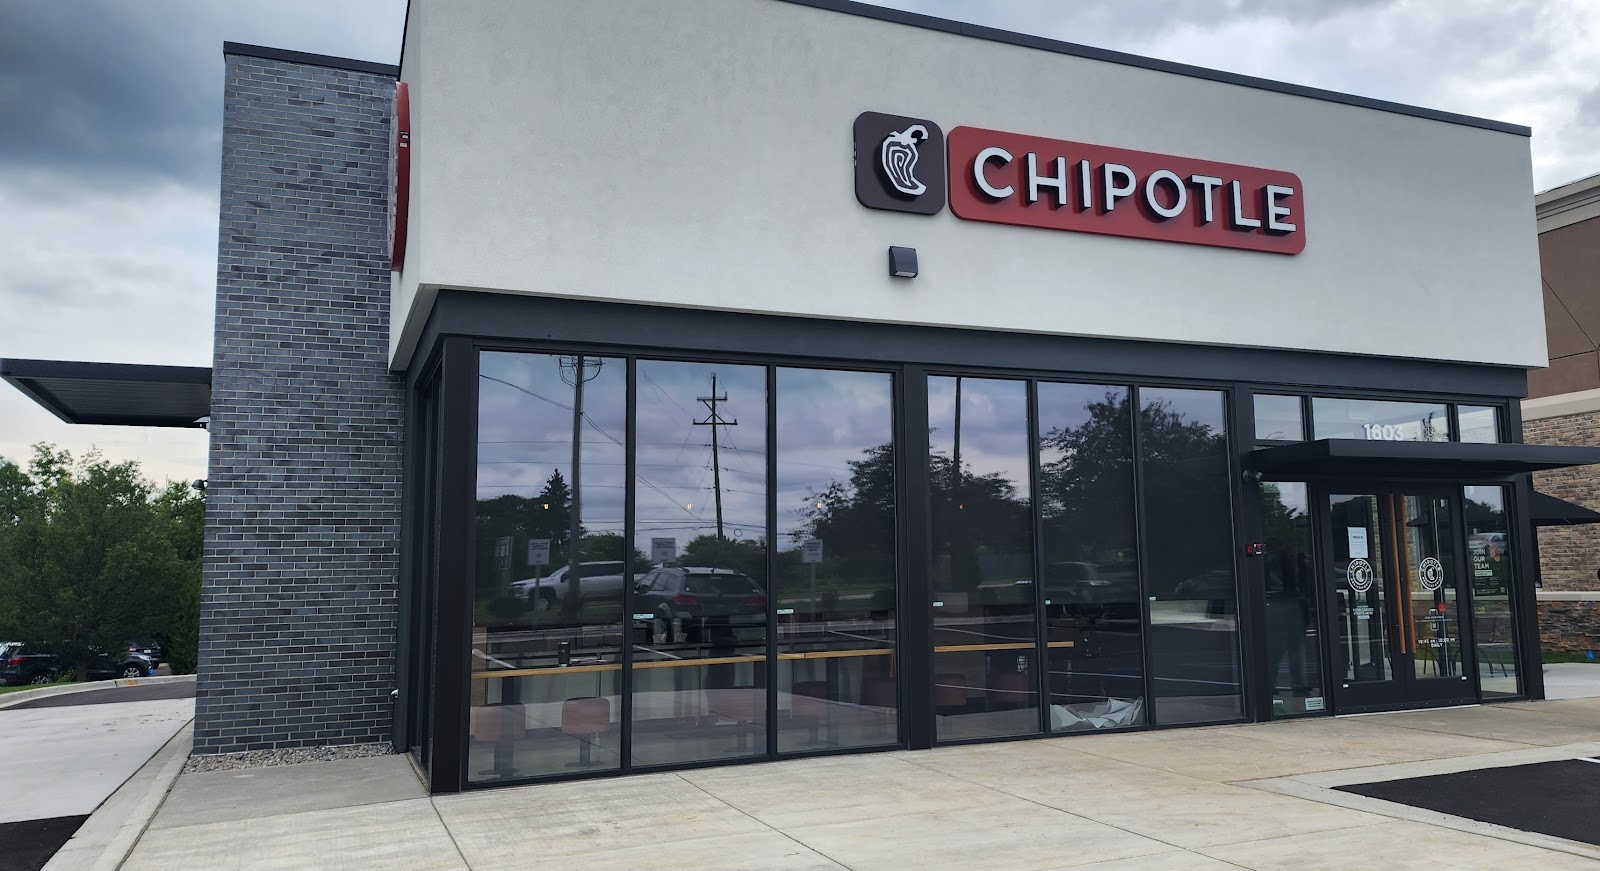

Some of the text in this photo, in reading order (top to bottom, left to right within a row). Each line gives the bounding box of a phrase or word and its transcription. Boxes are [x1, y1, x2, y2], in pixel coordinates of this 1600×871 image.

[972, 146, 1297, 233] CHIPOTLE
[1363, 423, 1404, 441] 1603
[1349, 560, 1371, 573] CHIPOTLE
[1420, 559, 1442, 572] CHIPOTLE
